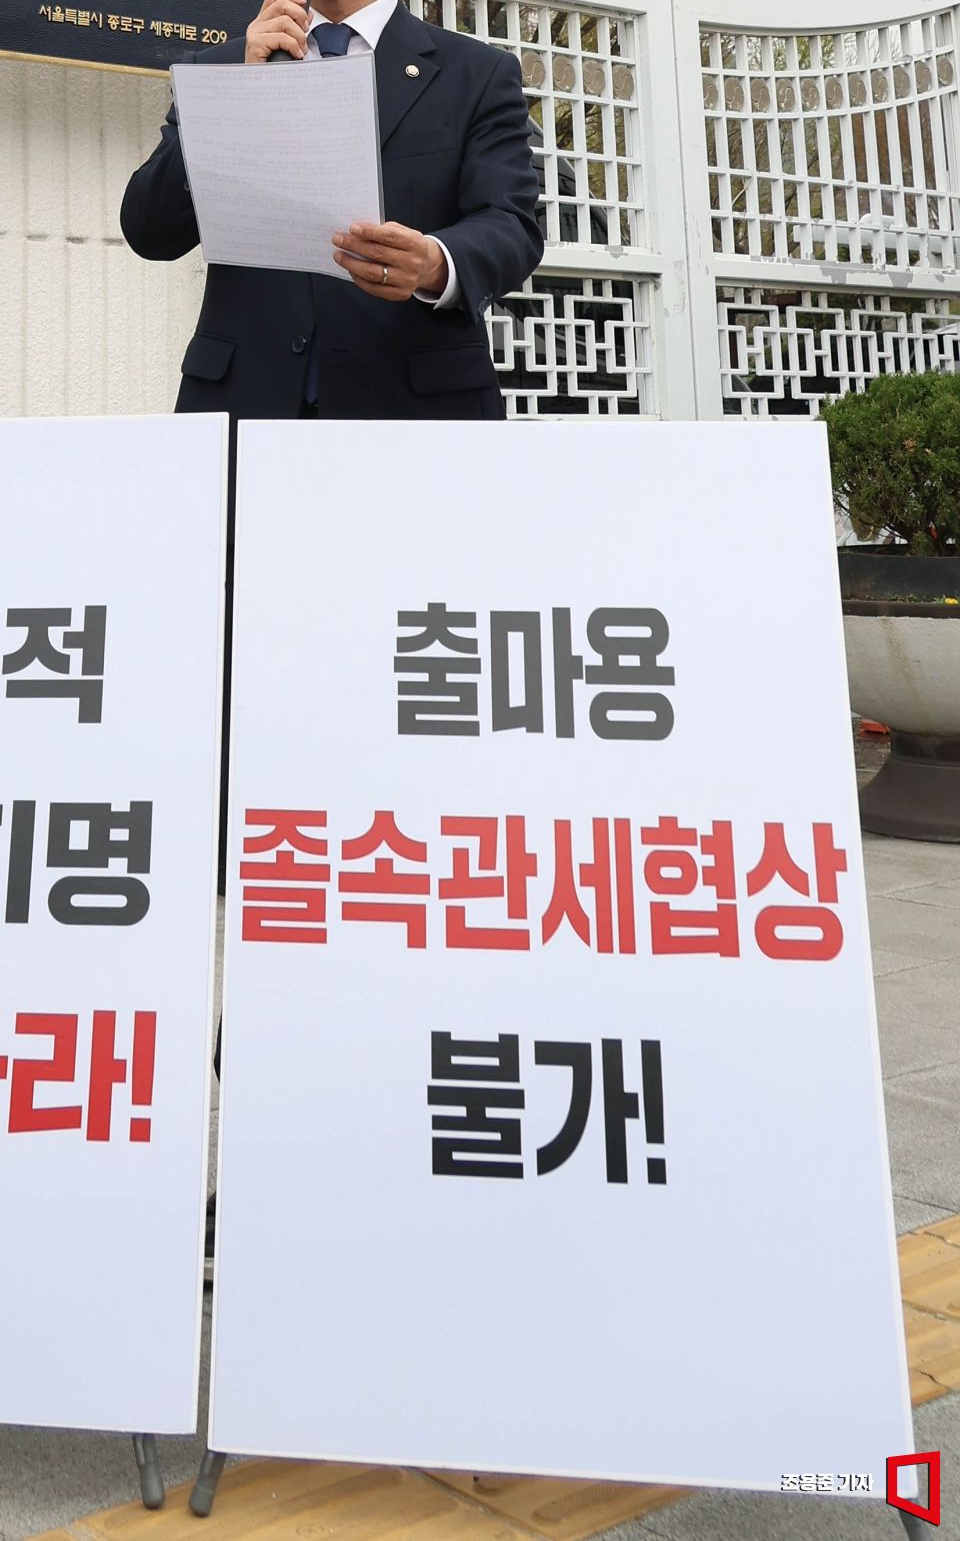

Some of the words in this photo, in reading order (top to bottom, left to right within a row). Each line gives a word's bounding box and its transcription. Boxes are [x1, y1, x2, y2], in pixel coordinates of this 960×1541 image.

[39, 5, 102, 28] 서울특별시
[108, 14, 145, 34] 종로구
[150, 20, 197, 41] 세종대로
[202, 28, 227, 44] 209
[394, 603, 675, 740] 출마용
[240, 809, 846, 961] 졸속관세협상
[427, 1031, 666, 1184] 불가!
